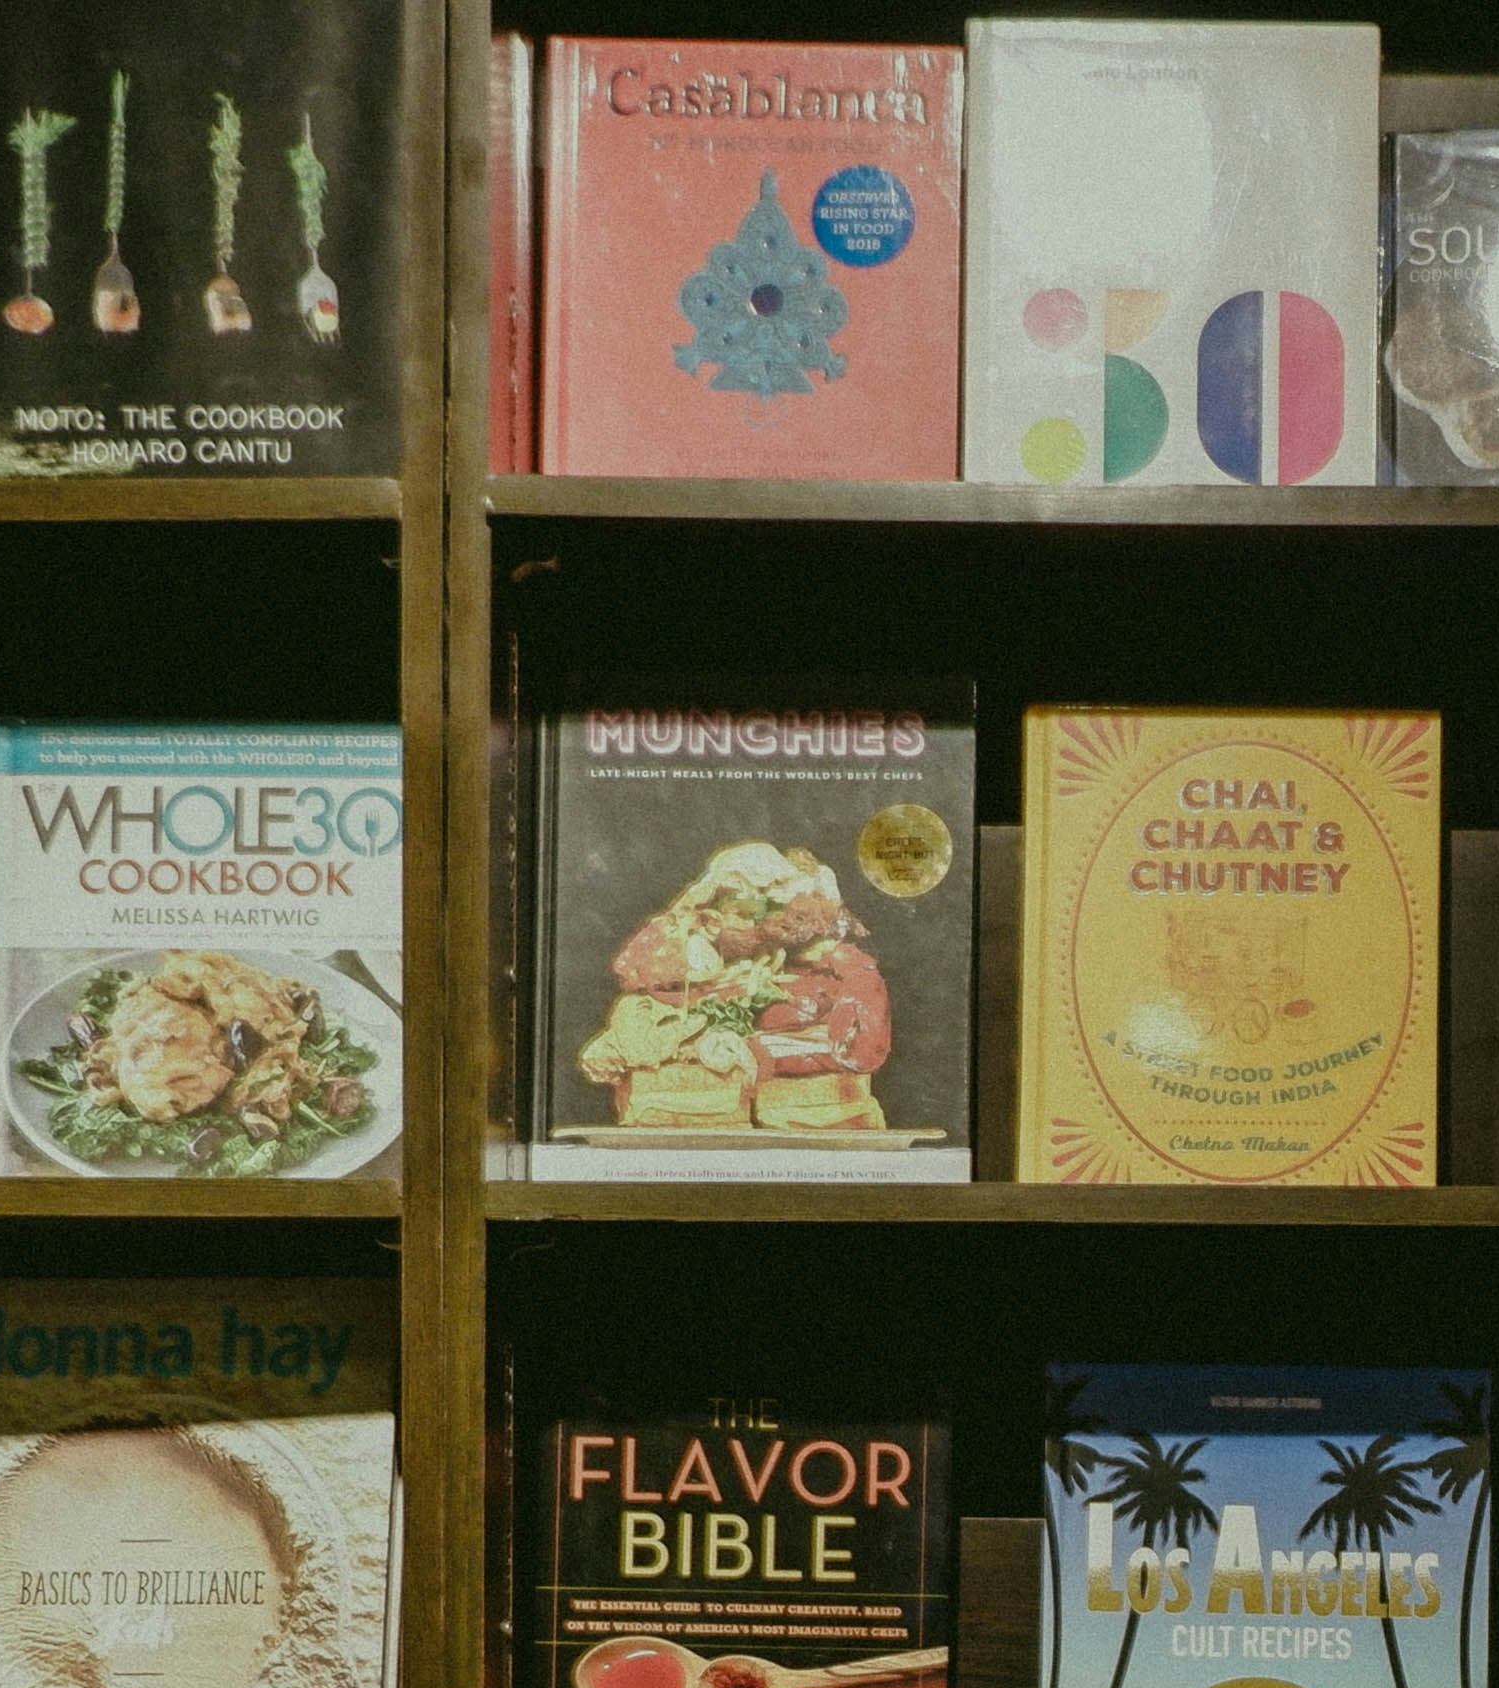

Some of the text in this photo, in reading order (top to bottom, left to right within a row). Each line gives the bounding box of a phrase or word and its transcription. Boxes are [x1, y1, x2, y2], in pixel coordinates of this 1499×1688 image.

[605, 68, 928, 128] Casablanca
[820, 206, 909, 220] RISING STAR
[833, 222, 894, 236] IN FOOD
[17, 408, 344, 431] MOTO: THE COOKBOOK
[71, 440, 293, 463] HOMARO CANTU
[589, 709, 926, 757] MUNCHIES
[590, 768, 924, 782] LATE-NIGHT MEALS FROM THE WORLD'S BEST CHEFS
[1177, 778, 1308, 814] CHAI,
[1142, 821, 1346, 854] CHAAT &
[79, 860, 352, 897] COOKBOOK
[1130, 861, 1351, 897] CHUTNEY
[568, 1435, 912, 1507] FLAVOR
[618, 1512, 857, 1583] BIBLE
[20, 1570, 266, 1607] BASICS TO BRILLIANCE
